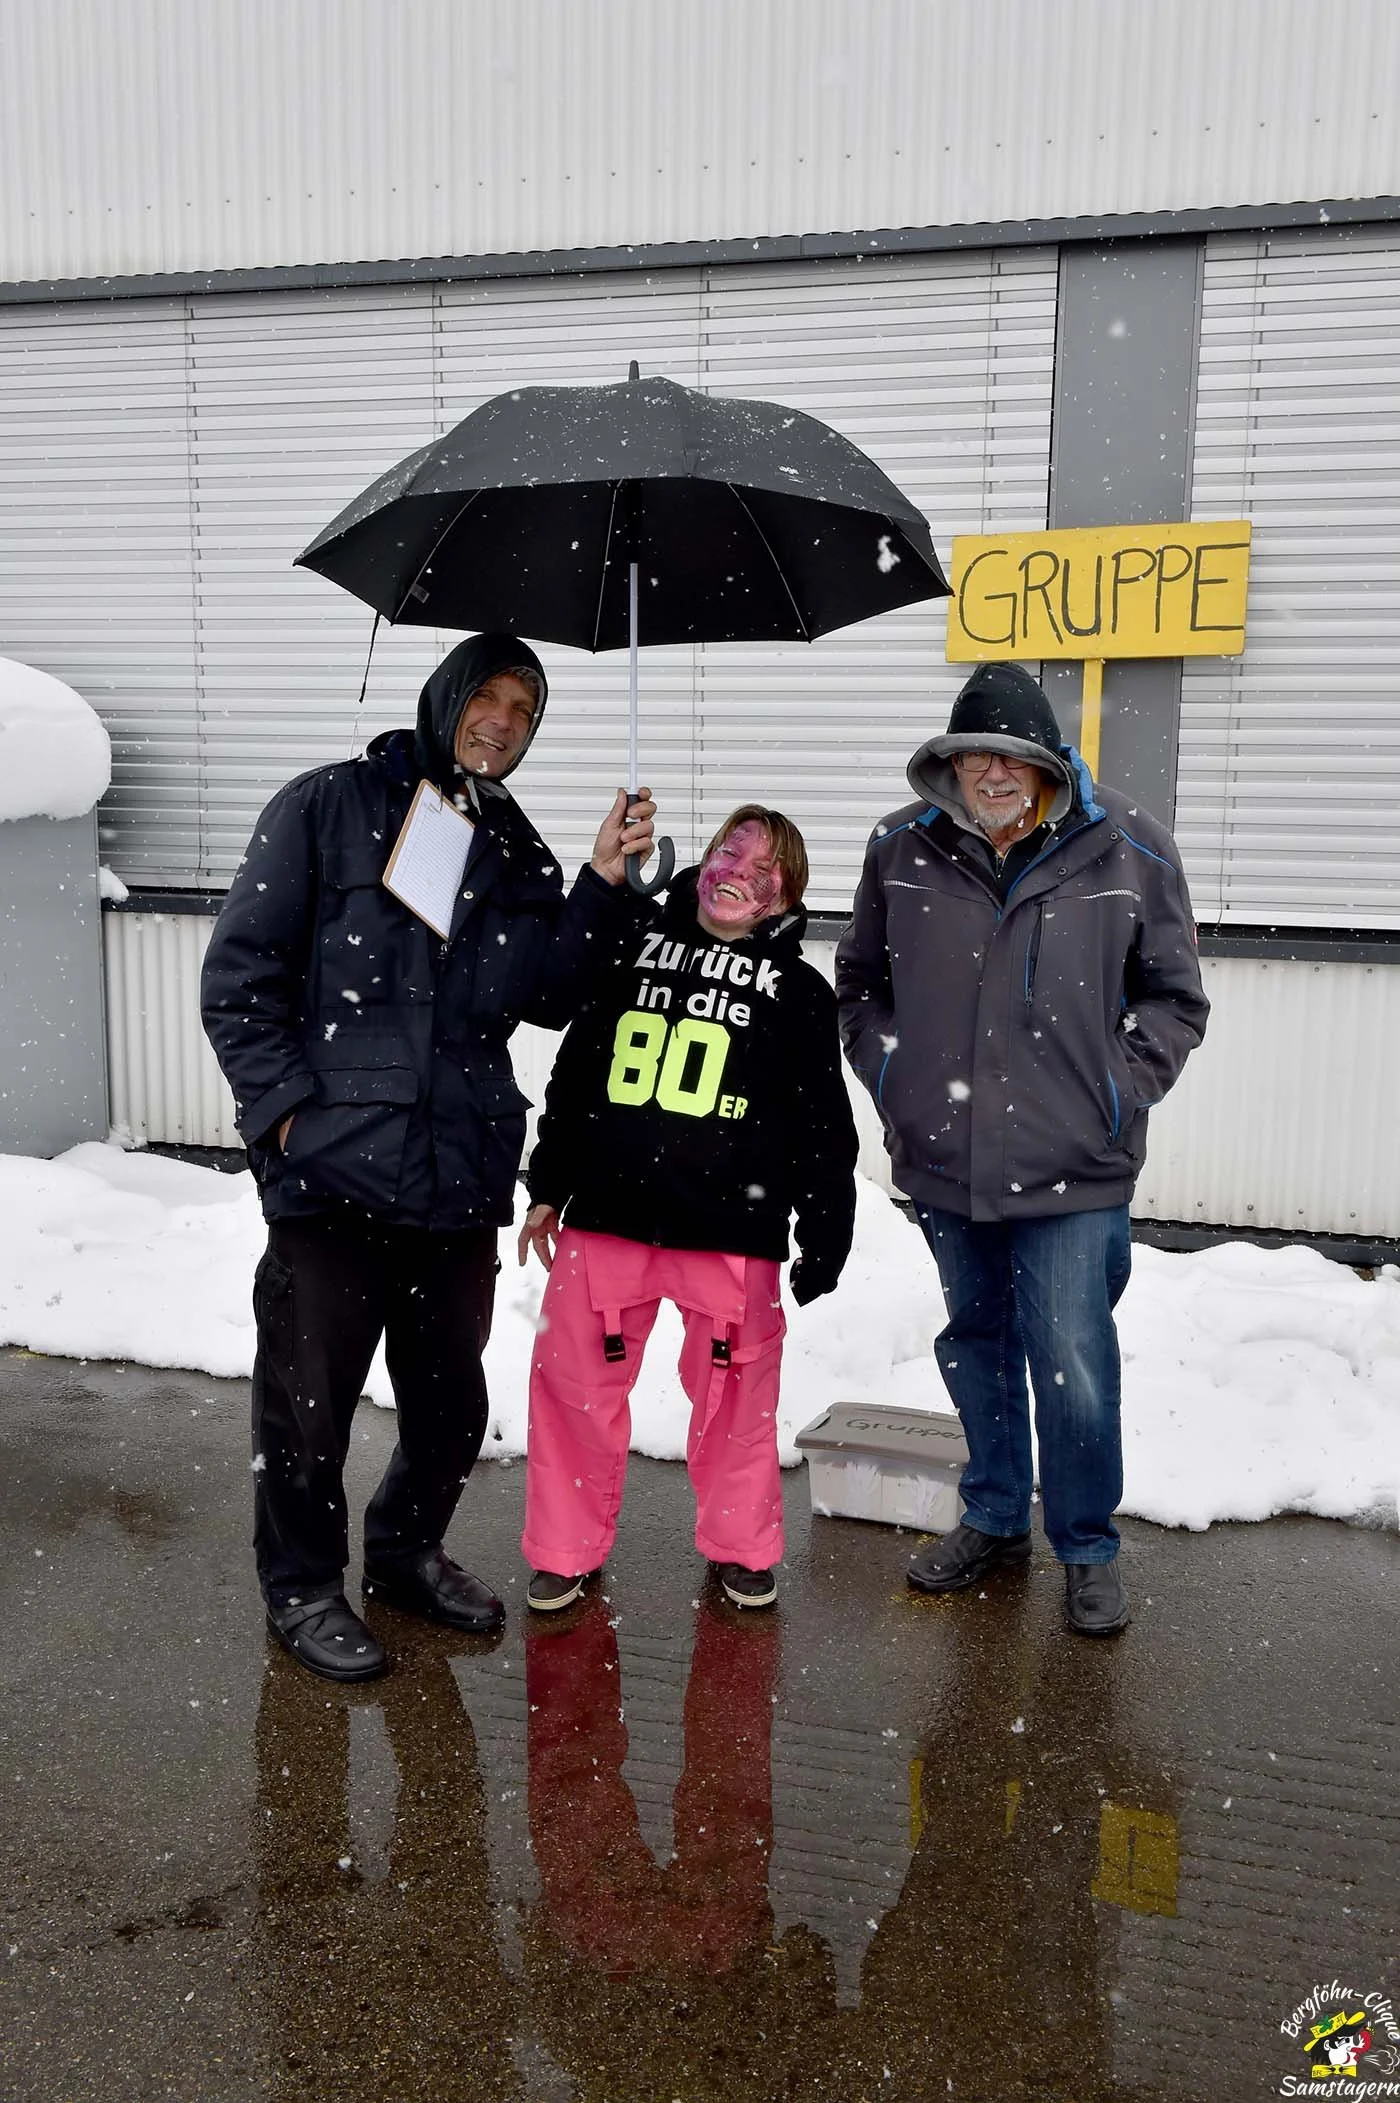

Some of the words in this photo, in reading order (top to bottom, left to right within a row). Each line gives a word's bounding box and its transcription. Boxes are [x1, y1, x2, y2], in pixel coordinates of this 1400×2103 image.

[958, 543, 1250, 648] GRUPPE
[634, 932, 783, 999] Zurück
[636, 978, 672, 1009] in
[686, 988, 751, 1027] die
